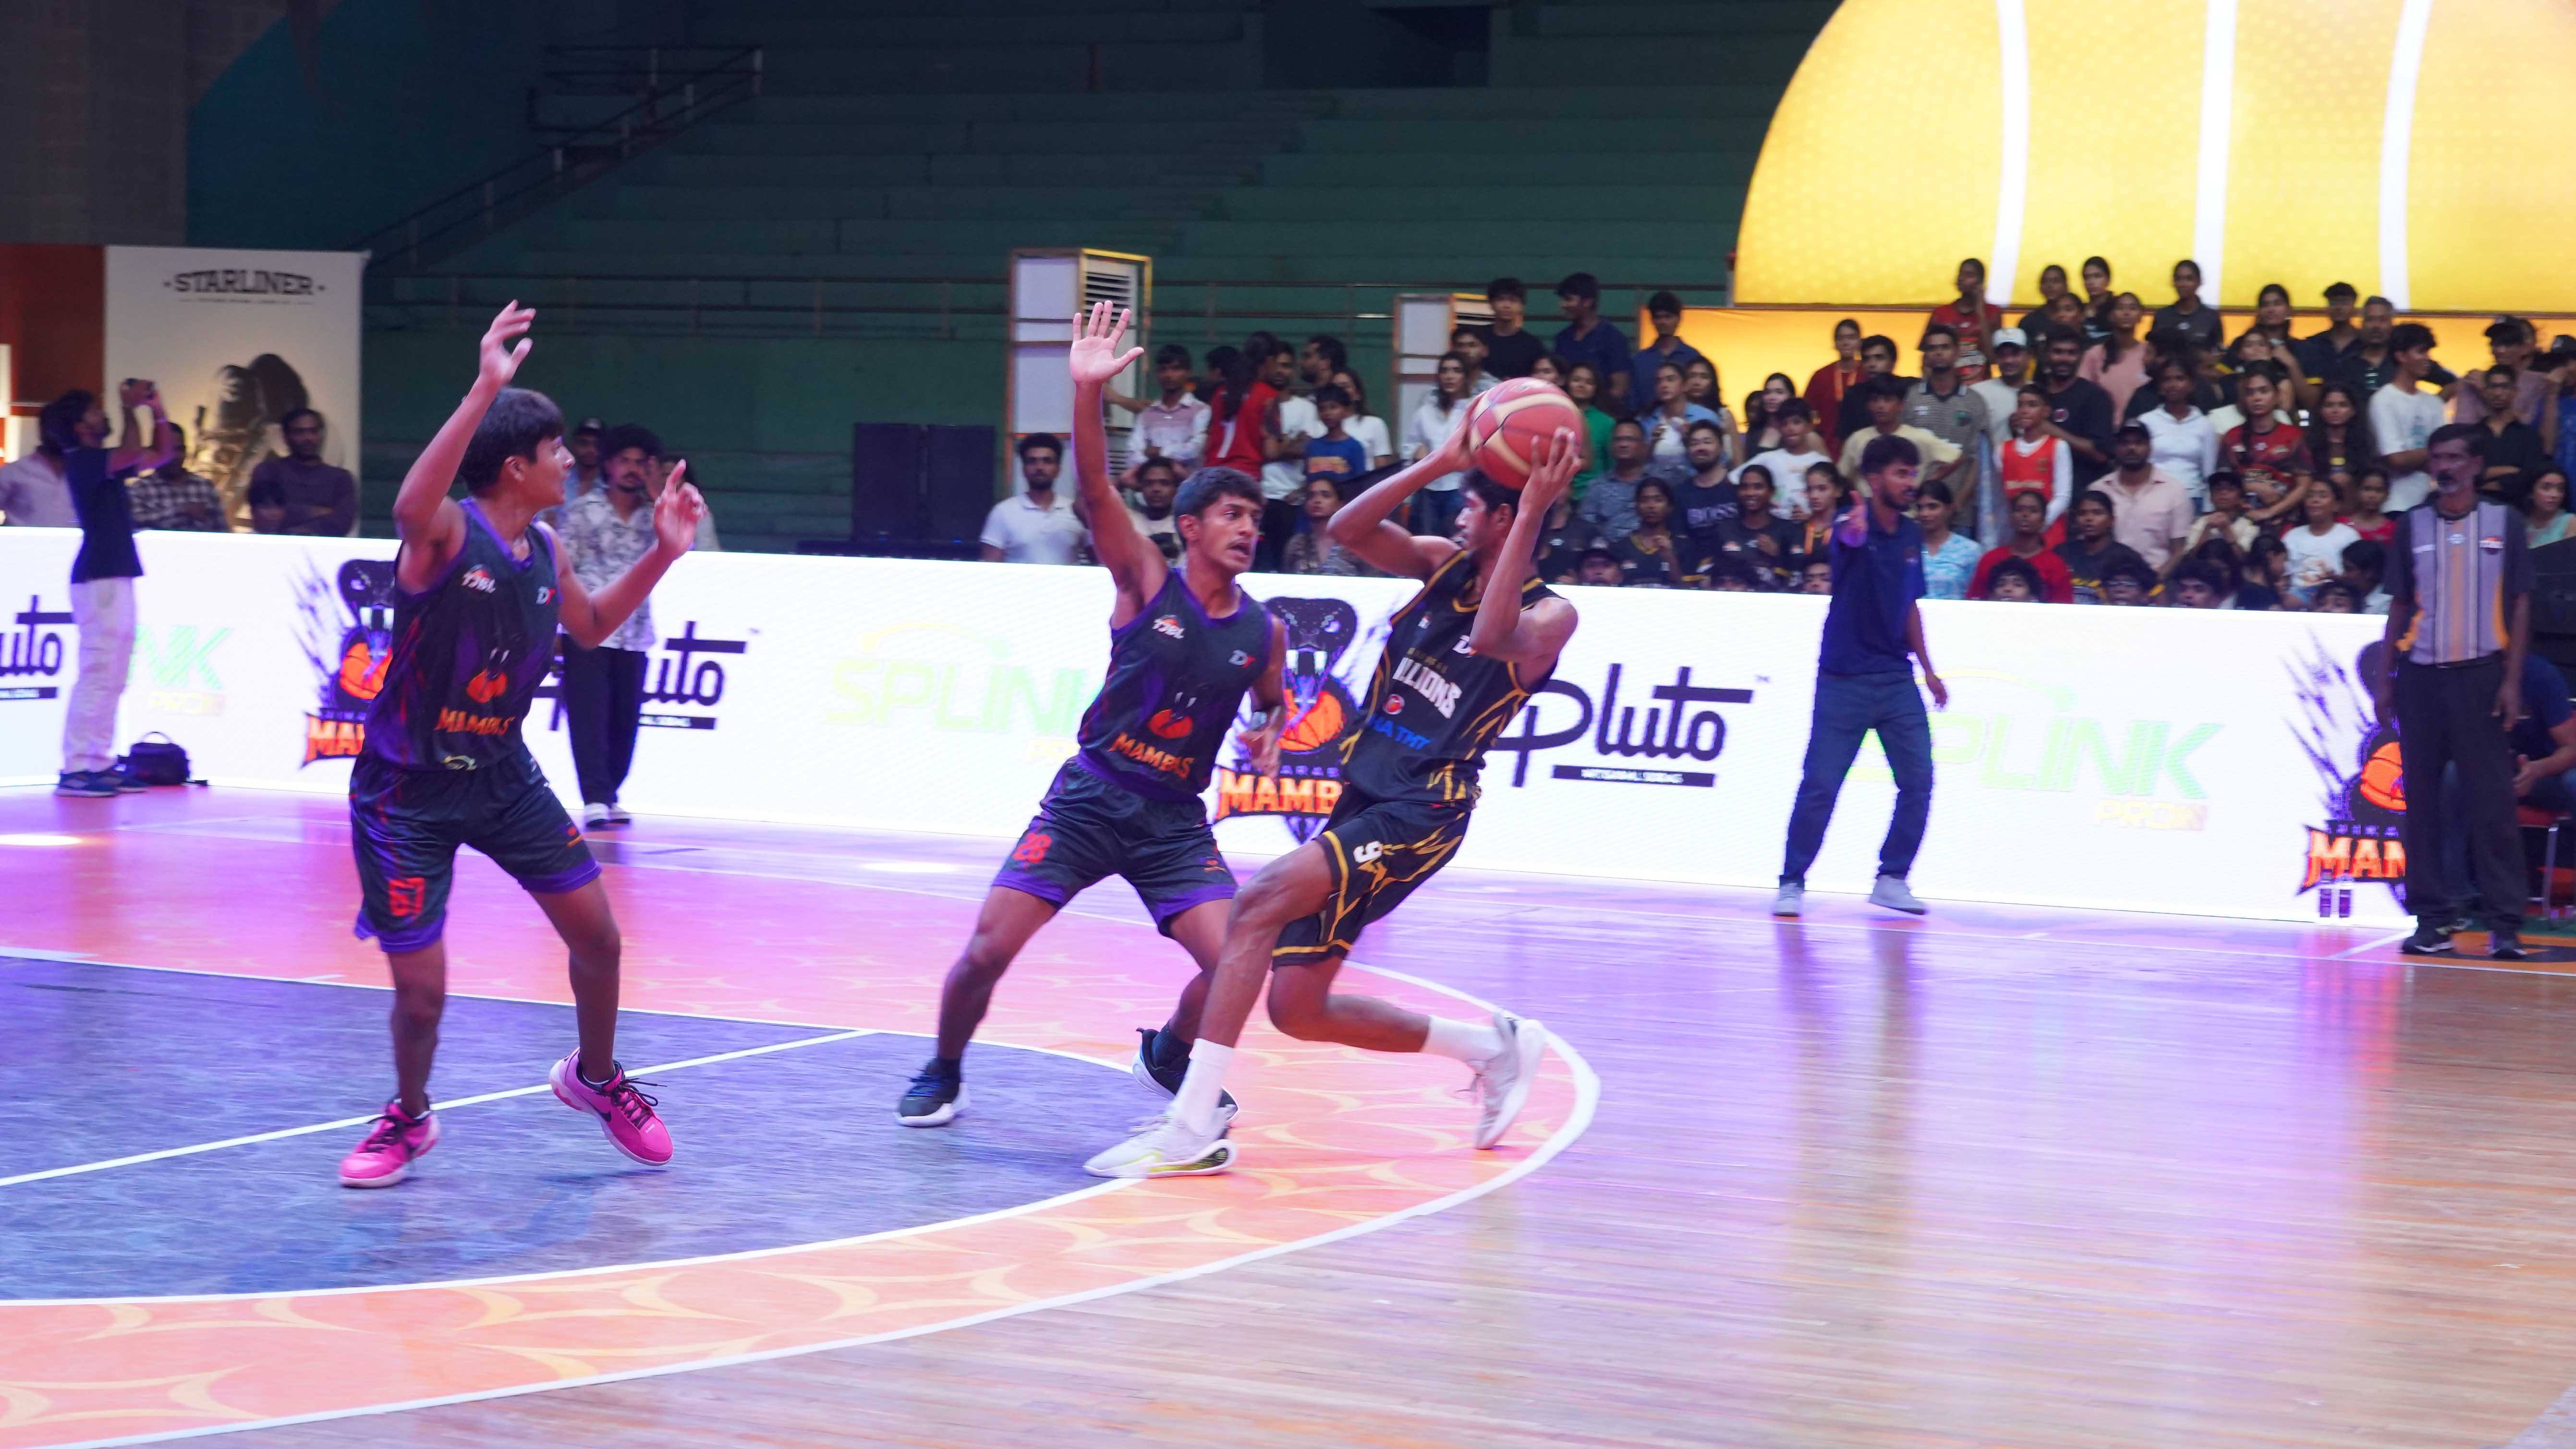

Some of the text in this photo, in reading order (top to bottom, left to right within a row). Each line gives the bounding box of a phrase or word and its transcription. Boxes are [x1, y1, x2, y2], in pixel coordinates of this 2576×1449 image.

[174, 269, 315, 296] STARLINER
[0, 594, 77, 676] uto
[1487, 663, 1754, 788] Pluto
[1106, 732, 1195, 780] MAMBAS
[1216, 768, 1343, 819] MAMB
[1012, 833, 1052, 864] 28
